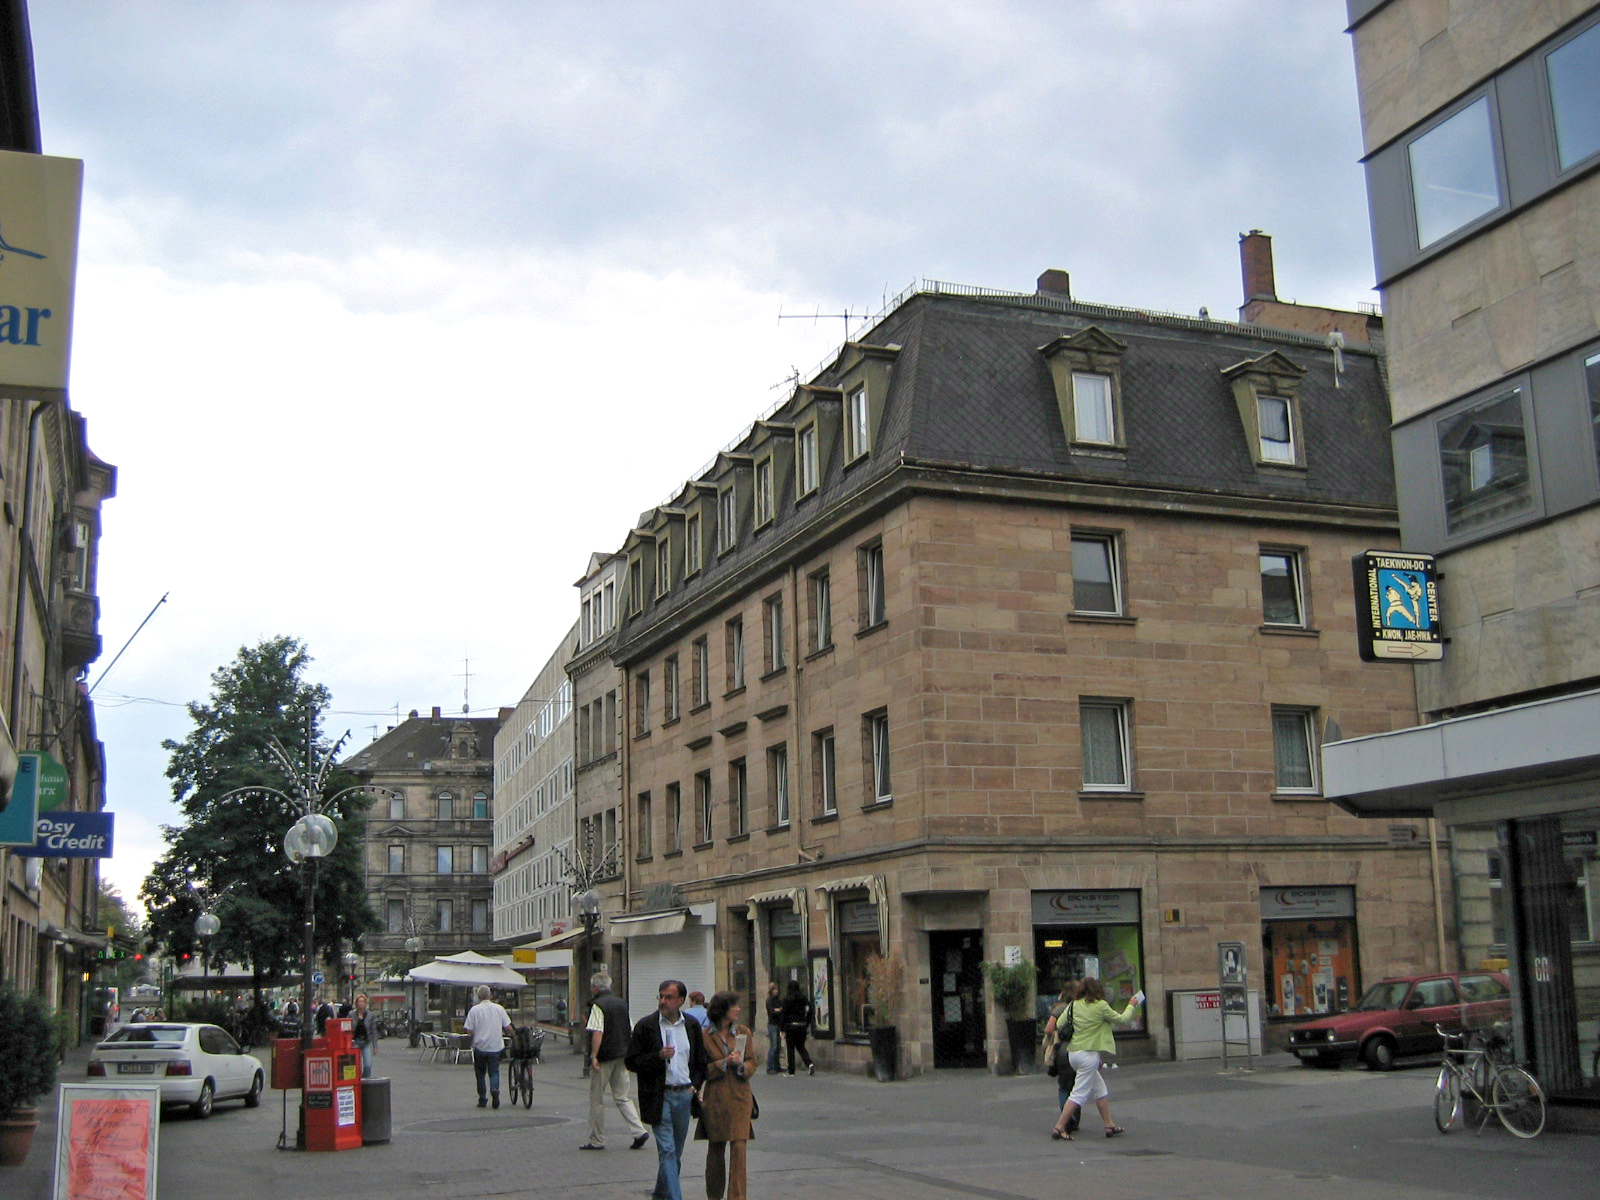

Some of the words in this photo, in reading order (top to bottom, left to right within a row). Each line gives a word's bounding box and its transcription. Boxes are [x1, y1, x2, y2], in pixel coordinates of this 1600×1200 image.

[1376, 557, 1425, 571] TAEKWON-DO
[1368, 568, 1381, 628] INTERNATIONAL
[1427, 581, 1438, 622] CENTER
[47, 834, 105, 850] Credit
